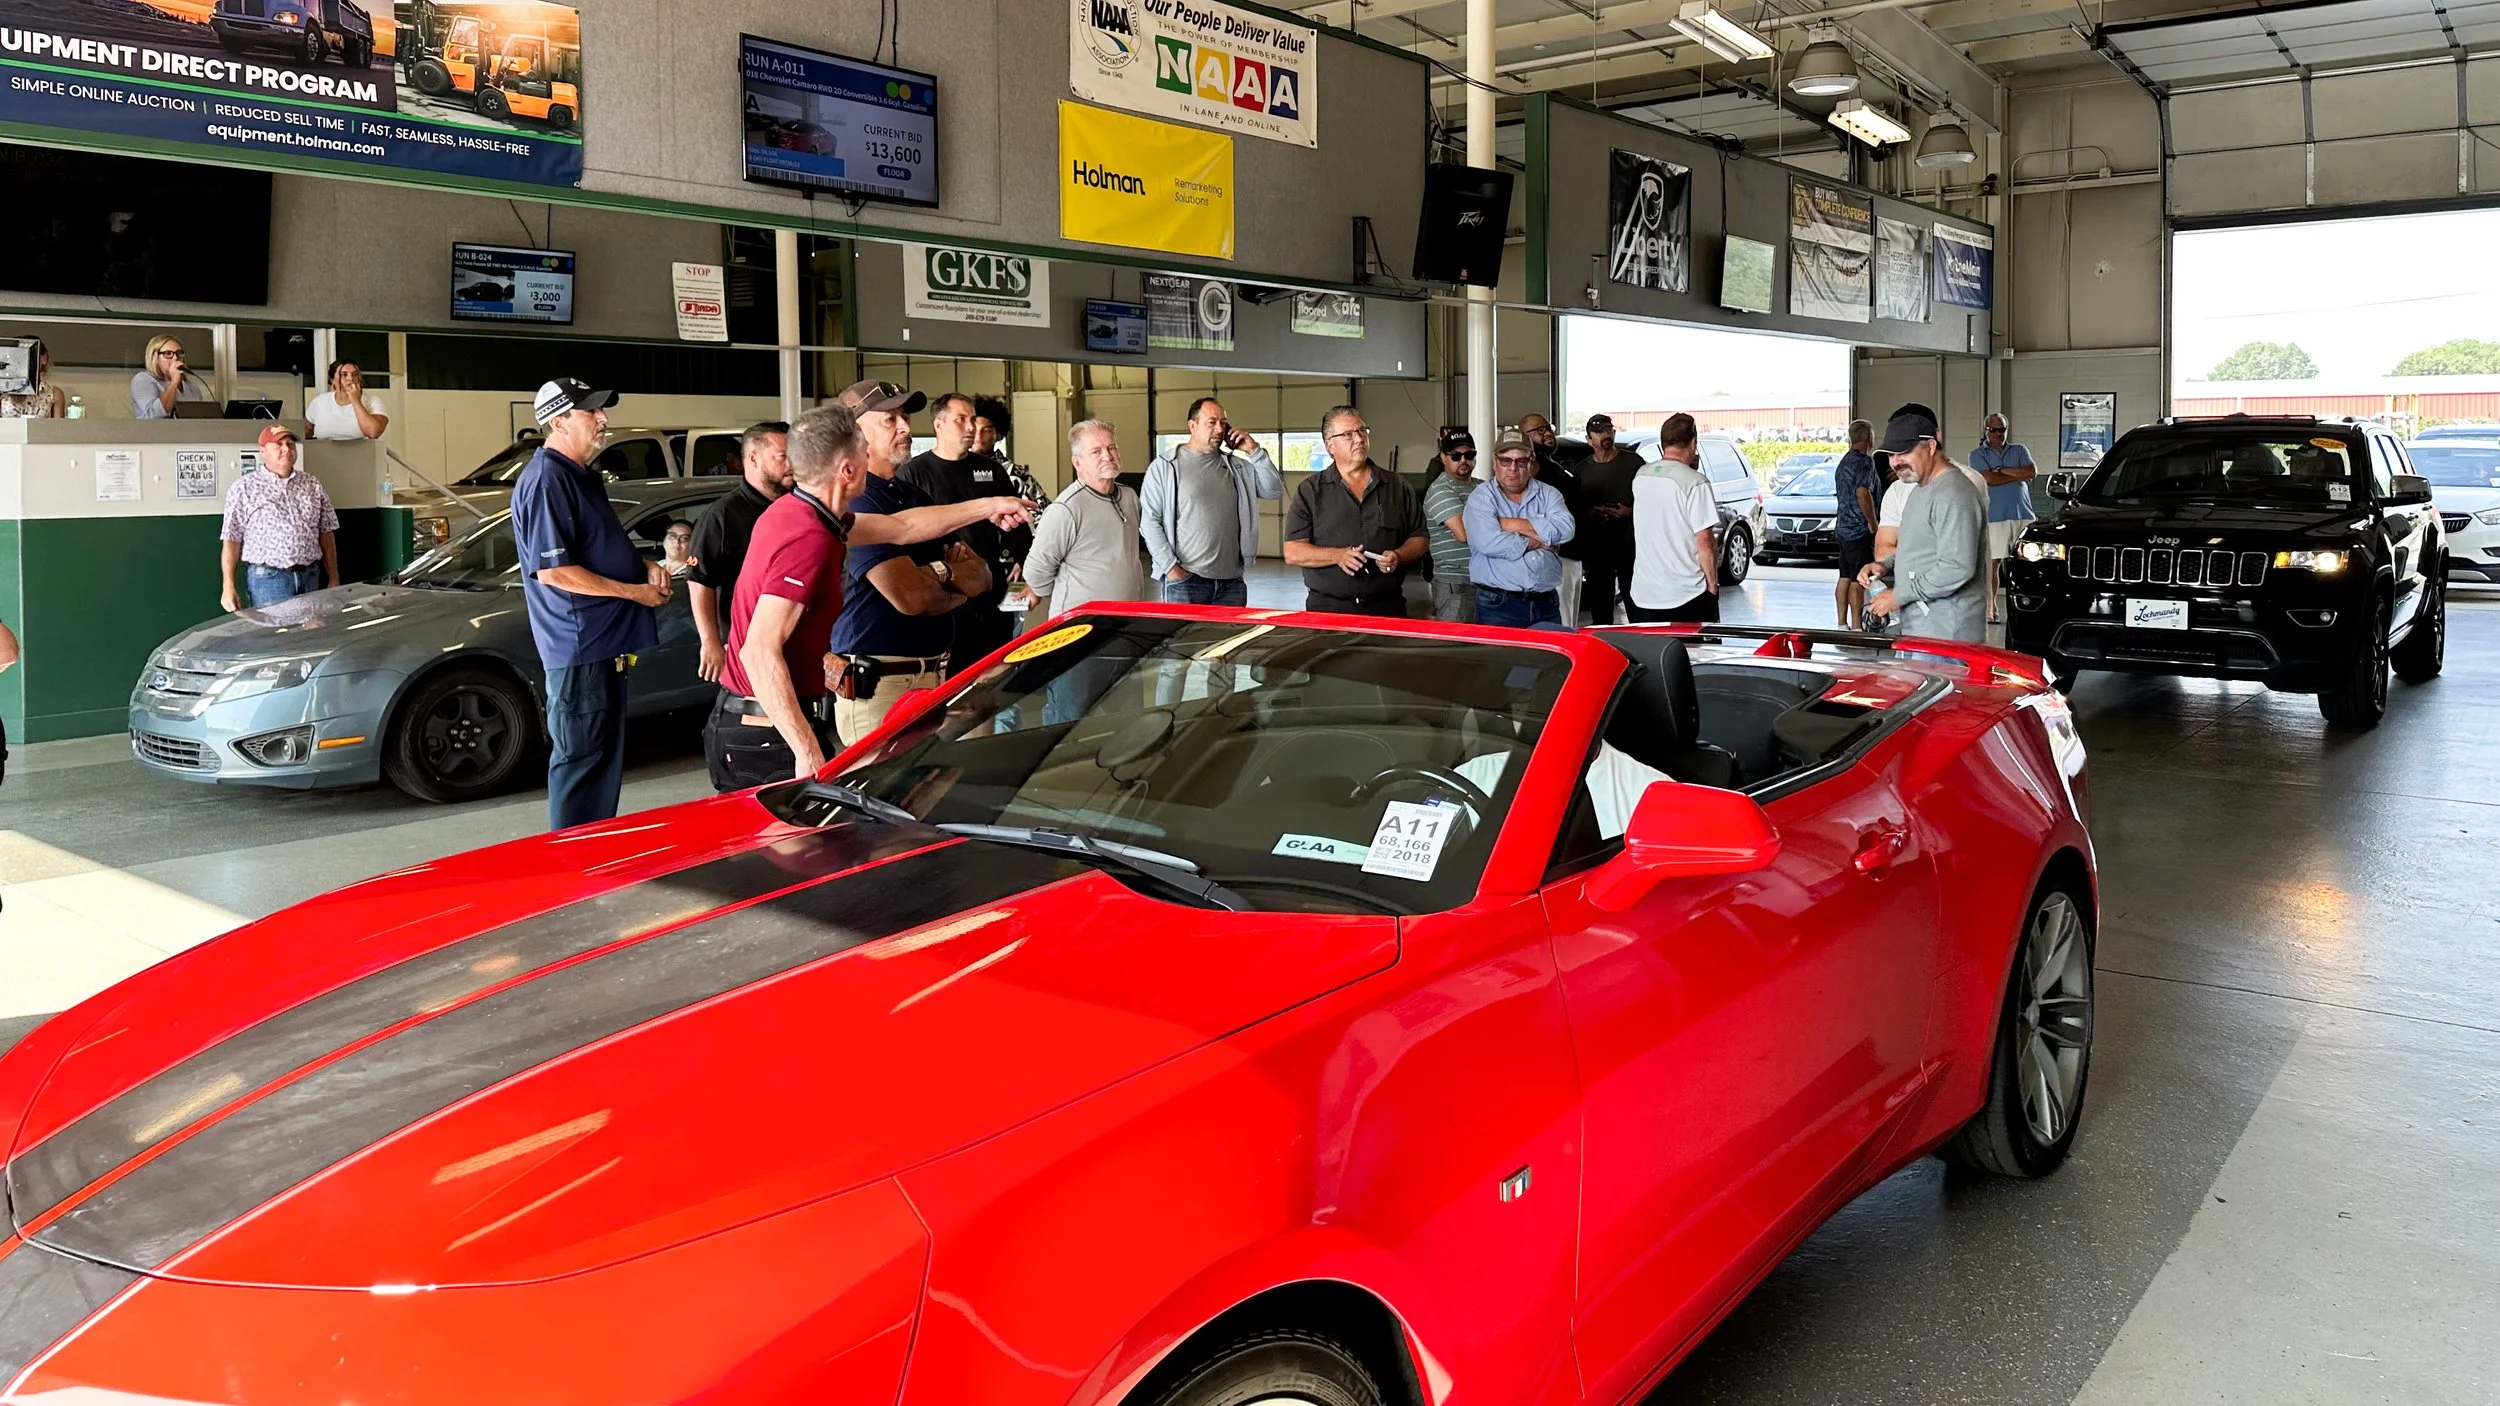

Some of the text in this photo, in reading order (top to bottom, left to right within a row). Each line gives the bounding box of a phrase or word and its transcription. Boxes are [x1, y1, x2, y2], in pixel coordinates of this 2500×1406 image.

[1092, 0, 1133, 36] NAAA
[1144, 0, 1305, 53] Our People Deliver Value
[1157, 21, 1298, 65] THE POWER OF MEMBERSHIP
[1091, 46, 1129, 66] ASSOCIATION
[142, 49, 242, 83] DIRECT
[245, 65, 377, 103] PROGRAM
[772, 58, 806, 76] A-011
[1156, 42, 1298, 112] NAAA
[760, 72, 791, 85] Chevrolet
[792, 78, 817, 90] Camaro
[818, 83, 833, 93] RWD
[842, 88, 878, 102] Convertible
[902, 101, 927, 112] Gasoline
[11, 76, 530, 156] SIMPLE ONLINE AUCTION REDUCED SELL TIME FAST, SEAMLESS, HASSLE-FREE
[1179, 104, 1281, 133] IN-LANE AND ONLINE
[207, 122, 385, 156] equipment.holman.com
[863, 123, 922, 144] CURRENT BID
[865, 140, 922, 166] $13,600
[884, 168, 905, 179] FLOOR
[1073, 160, 1146, 196] Holman
[1174, 178, 1223, 198] Remarketing
[1174, 191, 1209, 207] Solutions
[685, 266, 711, 277] STOP
[1149, 276, 1191, 288] NEXTGEAR
[1298, 297, 1360, 316] floored afc
[179, 454, 213, 462] CHECK IN
[2147, 535, 2180, 547] Jeep
[2134, 604, 2180, 622] Lochmandy
[1380, 815, 1439, 838] A11
[1392, 849, 1431, 864] 2018
